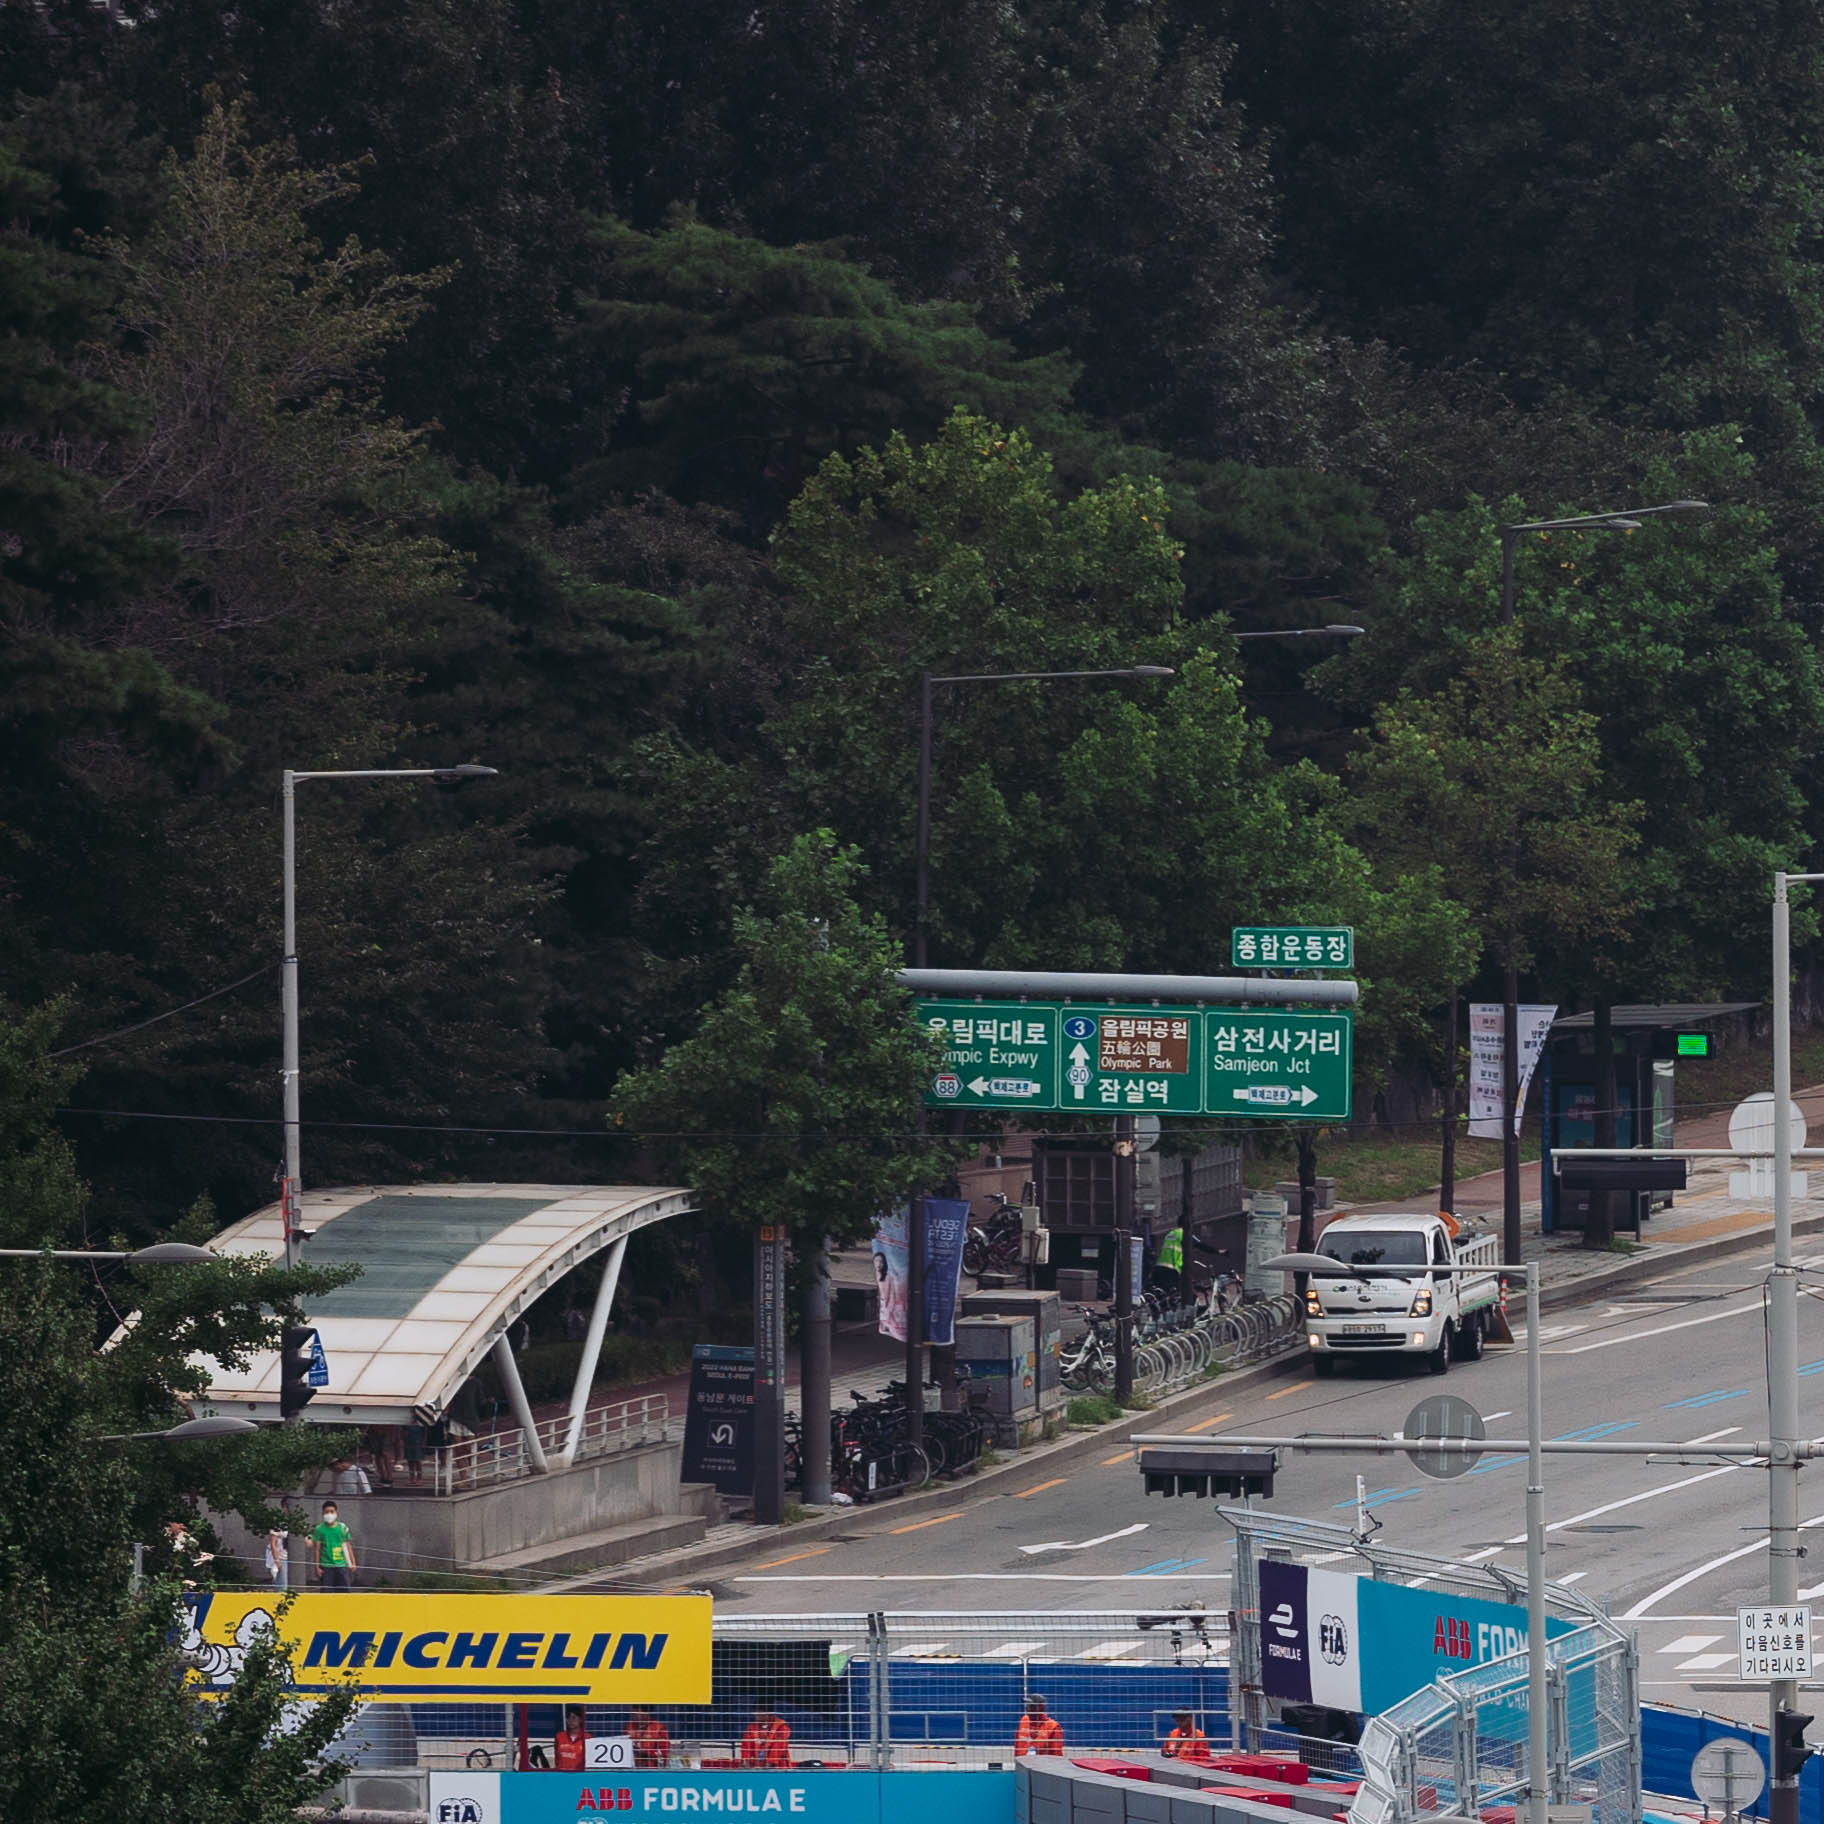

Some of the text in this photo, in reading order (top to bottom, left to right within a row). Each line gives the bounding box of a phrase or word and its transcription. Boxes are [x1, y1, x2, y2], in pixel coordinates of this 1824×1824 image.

[1236, 934, 1348, 964] 종합운동장
[1075, 1021, 1086, 1036] 3
[1101, 1017, 1189, 1040] 올림픽공원
[1213, 1026, 1341, 1056] 삼전사거리
[989, 1047, 1038, 1069] Expwy
[1101, 1056, 1173, 1073] Olympic Park
[1213, 1055, 1311, 1076] Samjeon Jct
[1071, 1067, 1089, 1085] 90
[938, 1081, 956, 1095] 88
[1098, 1077, 1170, 1104] 잠실역
[1433, 1615, 1473, 1660] ABB
[1744, 1635, 1806, 1654] 다음신호를
[303, 1630, 669, 1671] MICHELIN
[1744, 1657, 1807, 1676] 기다리시오
[593, 1744, 625, 1765] 20
[576, 1787, 806, 1812] ABB FORMULA E
